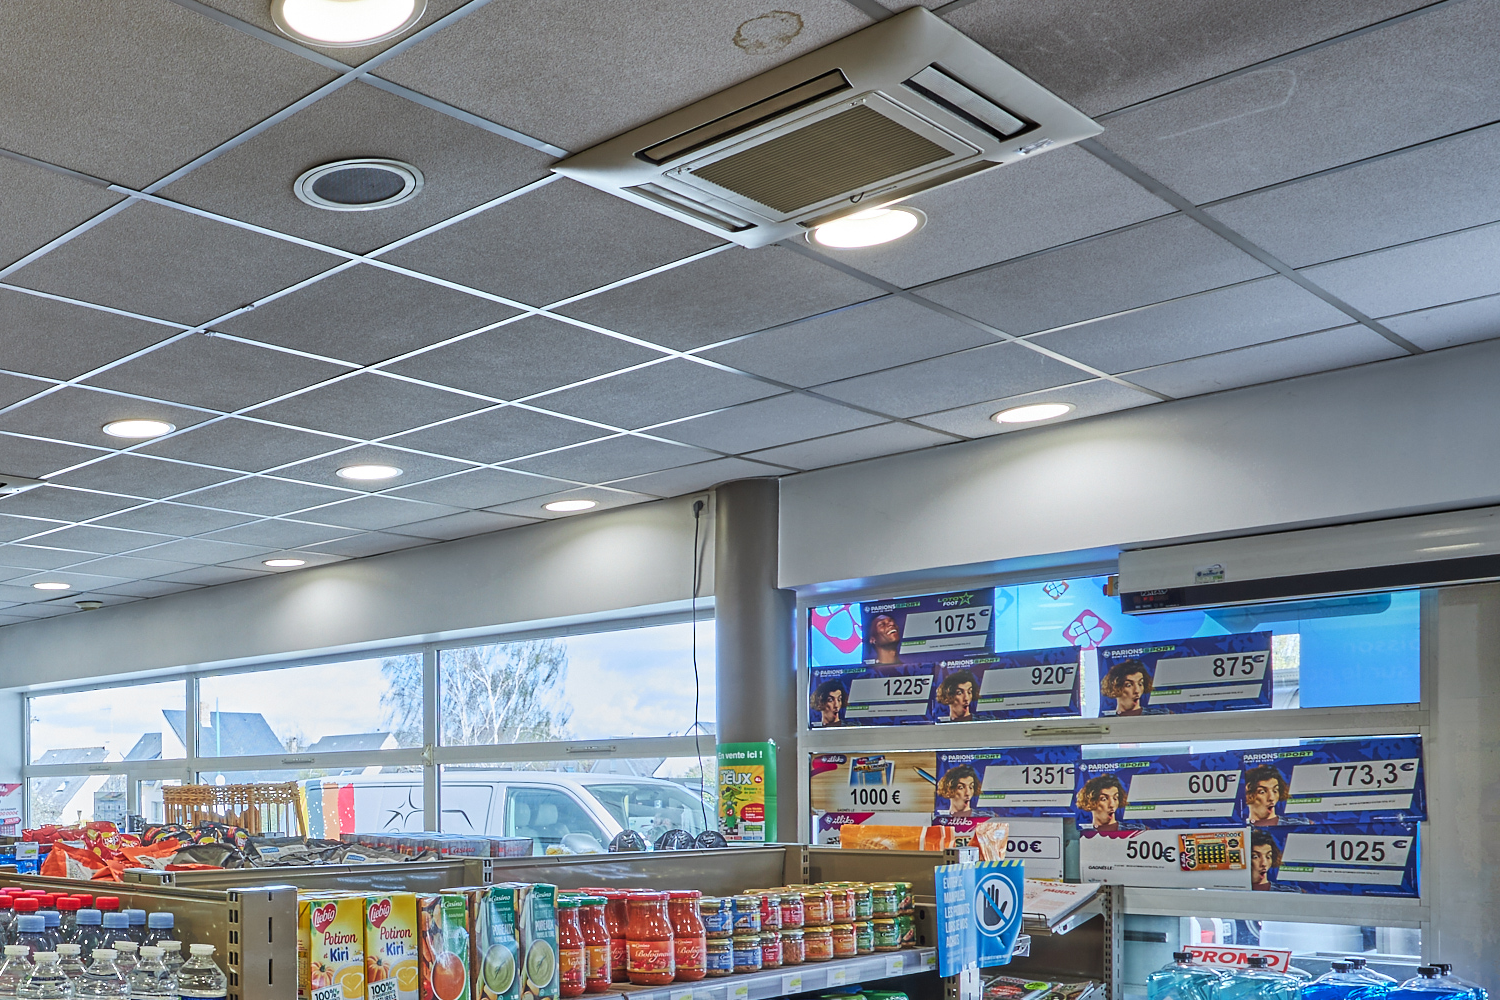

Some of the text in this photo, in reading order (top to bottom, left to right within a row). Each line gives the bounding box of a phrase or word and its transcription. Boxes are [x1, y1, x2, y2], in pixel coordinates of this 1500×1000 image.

[934, 609, 989, 633] 1075 €
[1031, 666, 1066, 685] 920
[1213, 655, 1254, 678] 875
[884, 678, 923, 696] 1225
[720, 772, 752, 785] JEUX
[1021, 766, 1065, 785] 1351
[1188, 774, 1227, 793] 600
[1328, 762, 1415, 788] 773,3 €
[850, 788, 900, 805] 1000 €
[832, 815, 854, 824] illiko
[947, 817, 972, 826] illiko
[1126, 840, 1176, 863] 500€
[1326, 840, 1408, 862] 1025 €
[369, 904, 391, 922] Liebig
[444, 899, 463, 909] Casino
[313, 910, 336, 927] Liebig
[324, 931, 358, 946] Potiron
[380, 926, 412, 940] Potiron
[330, 947, 350, 962] Kiri
[1190, 950, 1279, 968] PROMO
